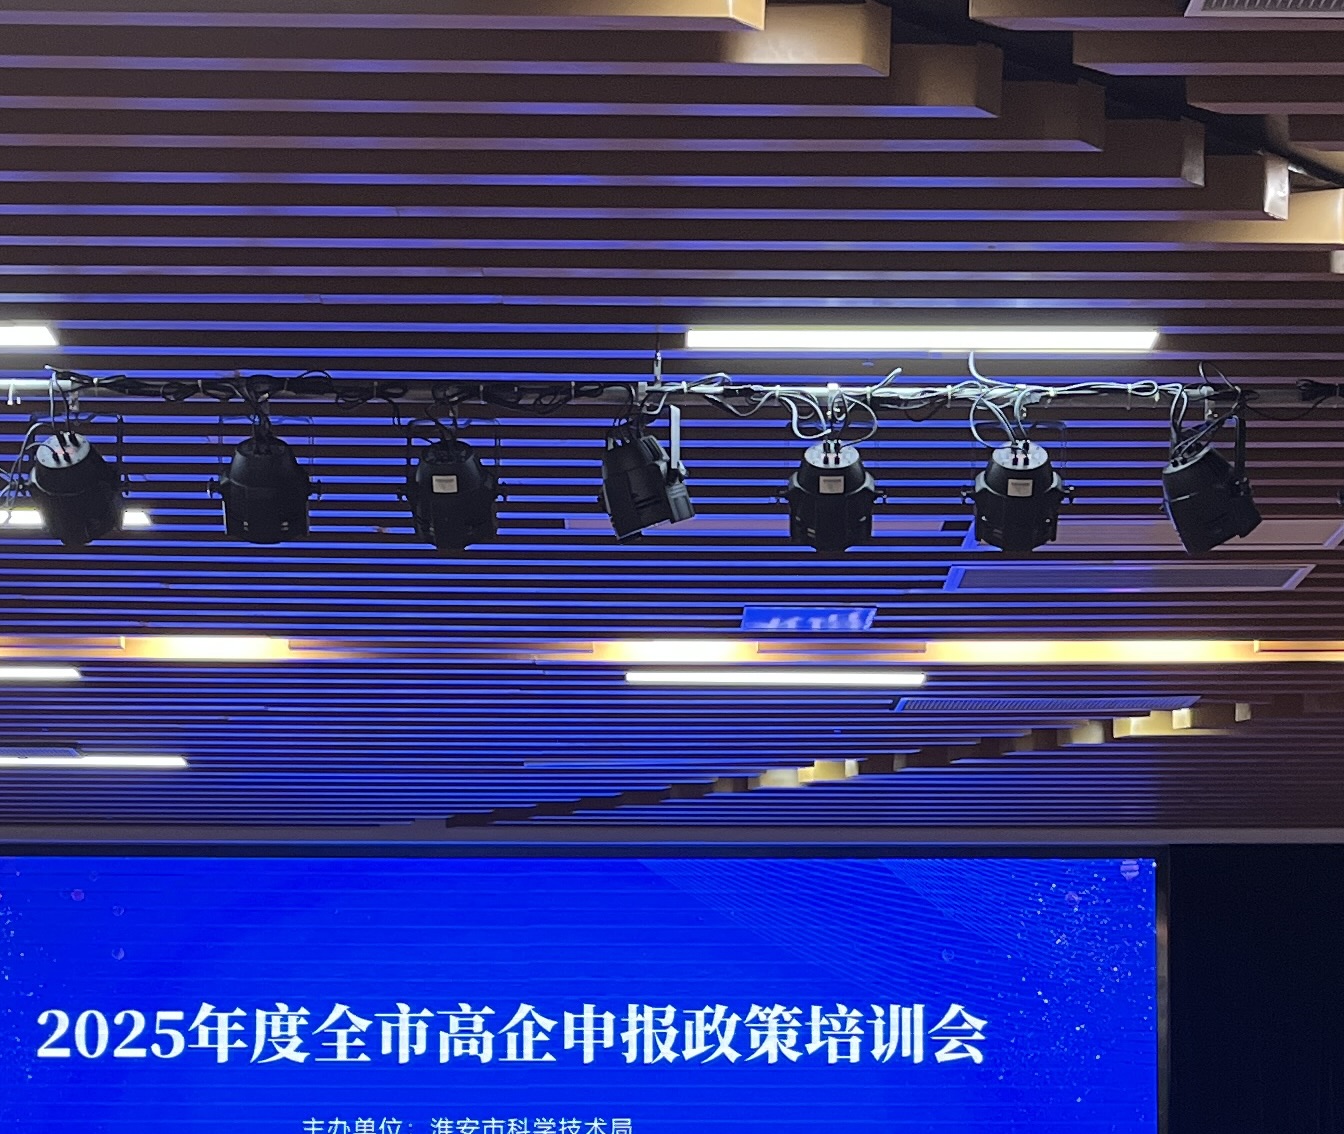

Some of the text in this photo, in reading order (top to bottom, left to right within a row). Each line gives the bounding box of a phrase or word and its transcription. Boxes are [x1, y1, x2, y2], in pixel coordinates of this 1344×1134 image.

[36, 1001, 989, 1065] 2025年度全市高企申报政策培训会
